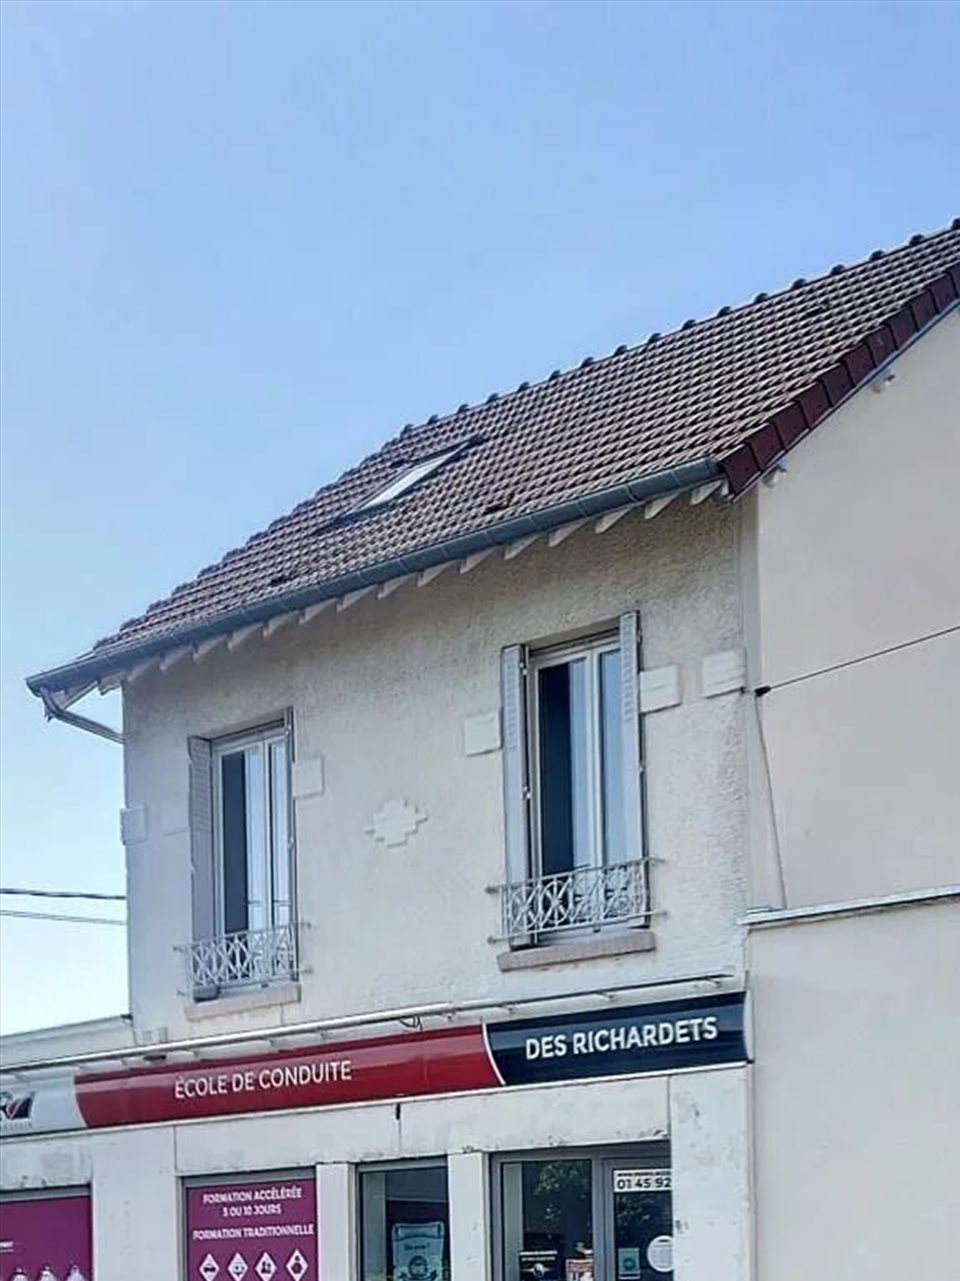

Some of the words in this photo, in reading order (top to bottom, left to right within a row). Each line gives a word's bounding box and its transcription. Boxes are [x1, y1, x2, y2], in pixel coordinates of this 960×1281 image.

[526, 1035, 567, 1060] DES
[573, 1017, 719, 1055] RICHARDETS
[175, 1075, 228, 1099] ÉCOLE
[232, 1071, 255, 1092] DE
[258, 1060, 352, 1089] CONDUITE
[617, 1179, 632, 1189] 01
[635, 1178, 651, 1188] 45
[655, 1177, 672, 1188] 92
[203, 1190, 252, 1204] FORMATION
[254, 1203, 282, 1214] JOURS
[193, 1228, 242, 1240] FORMATION
[244, 1223, 314, 1237] TRADITIONNELLE
